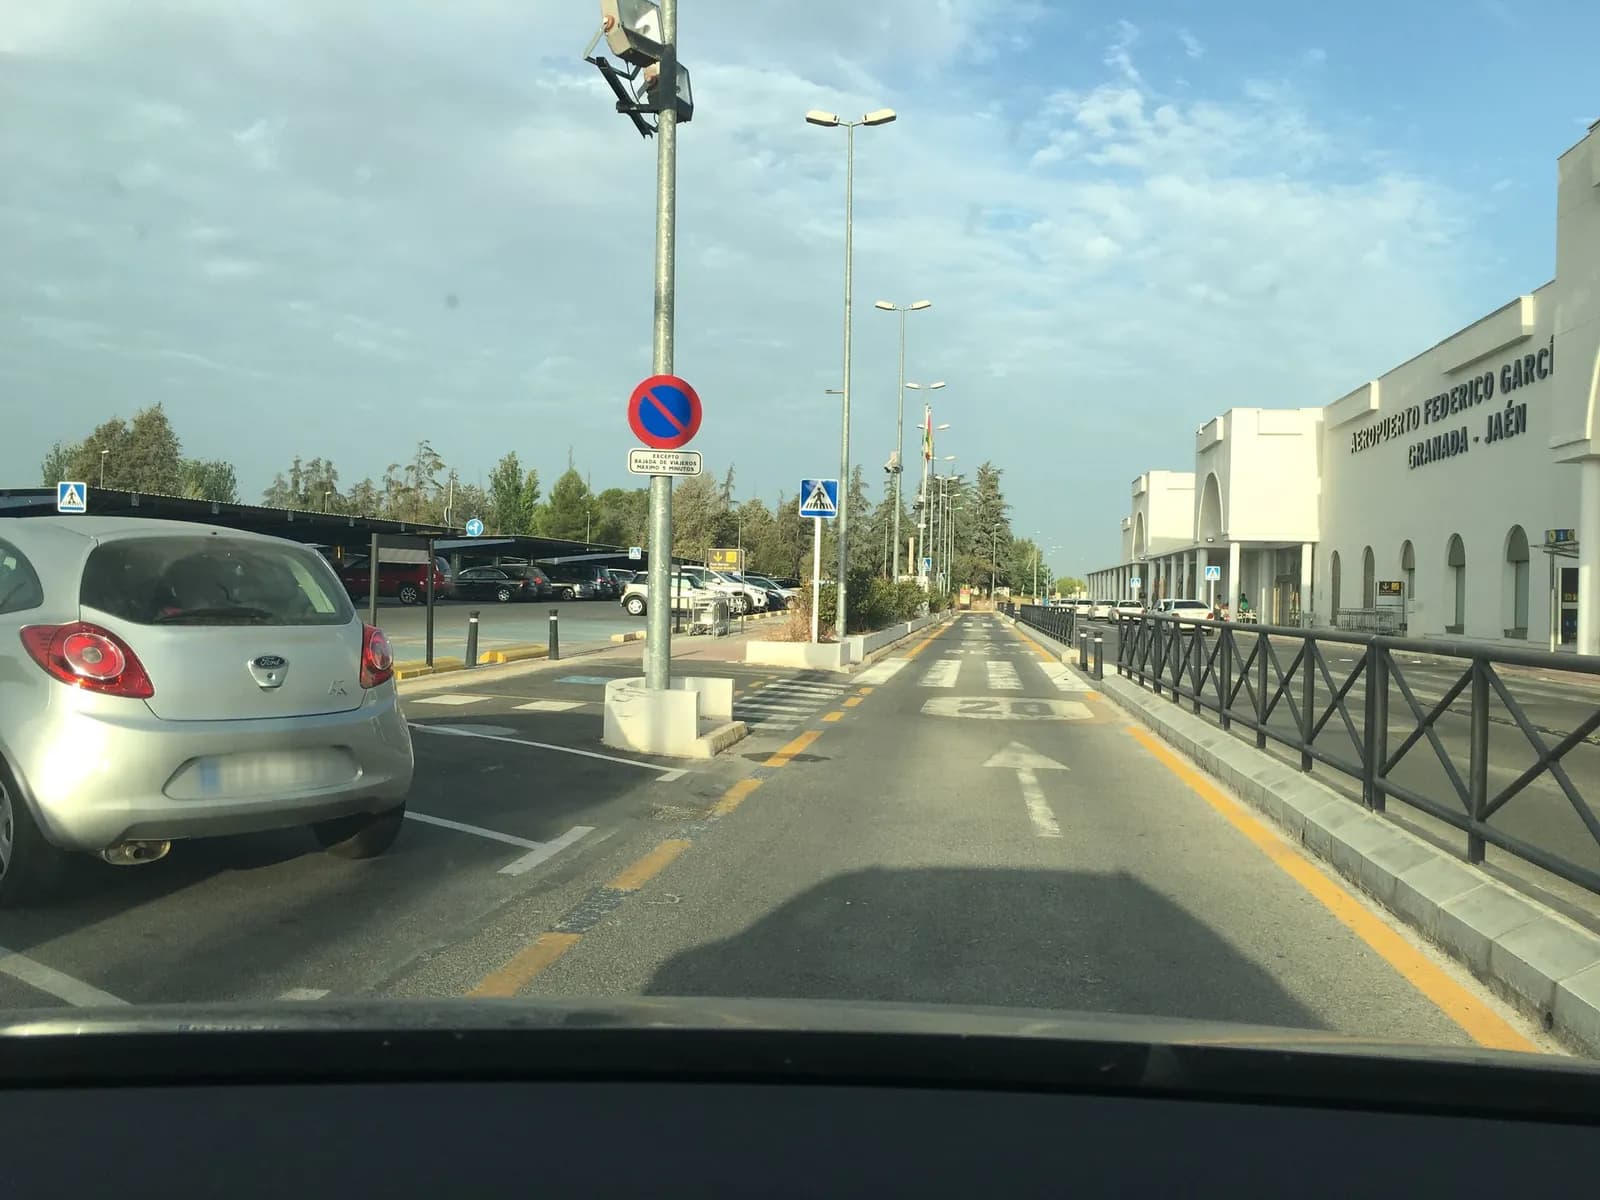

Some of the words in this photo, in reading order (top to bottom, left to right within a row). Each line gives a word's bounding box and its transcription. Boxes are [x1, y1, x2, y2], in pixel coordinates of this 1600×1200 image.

[1351, 405, 1420, 453] AEROPUERTO
[1424, 371, 1495, 425] FEDERICO
[1408, 426, 1469, 470] GRANADA
[1484, 399, 1527, 444] JAÉN
[257, 657, 283, 667] Ford
